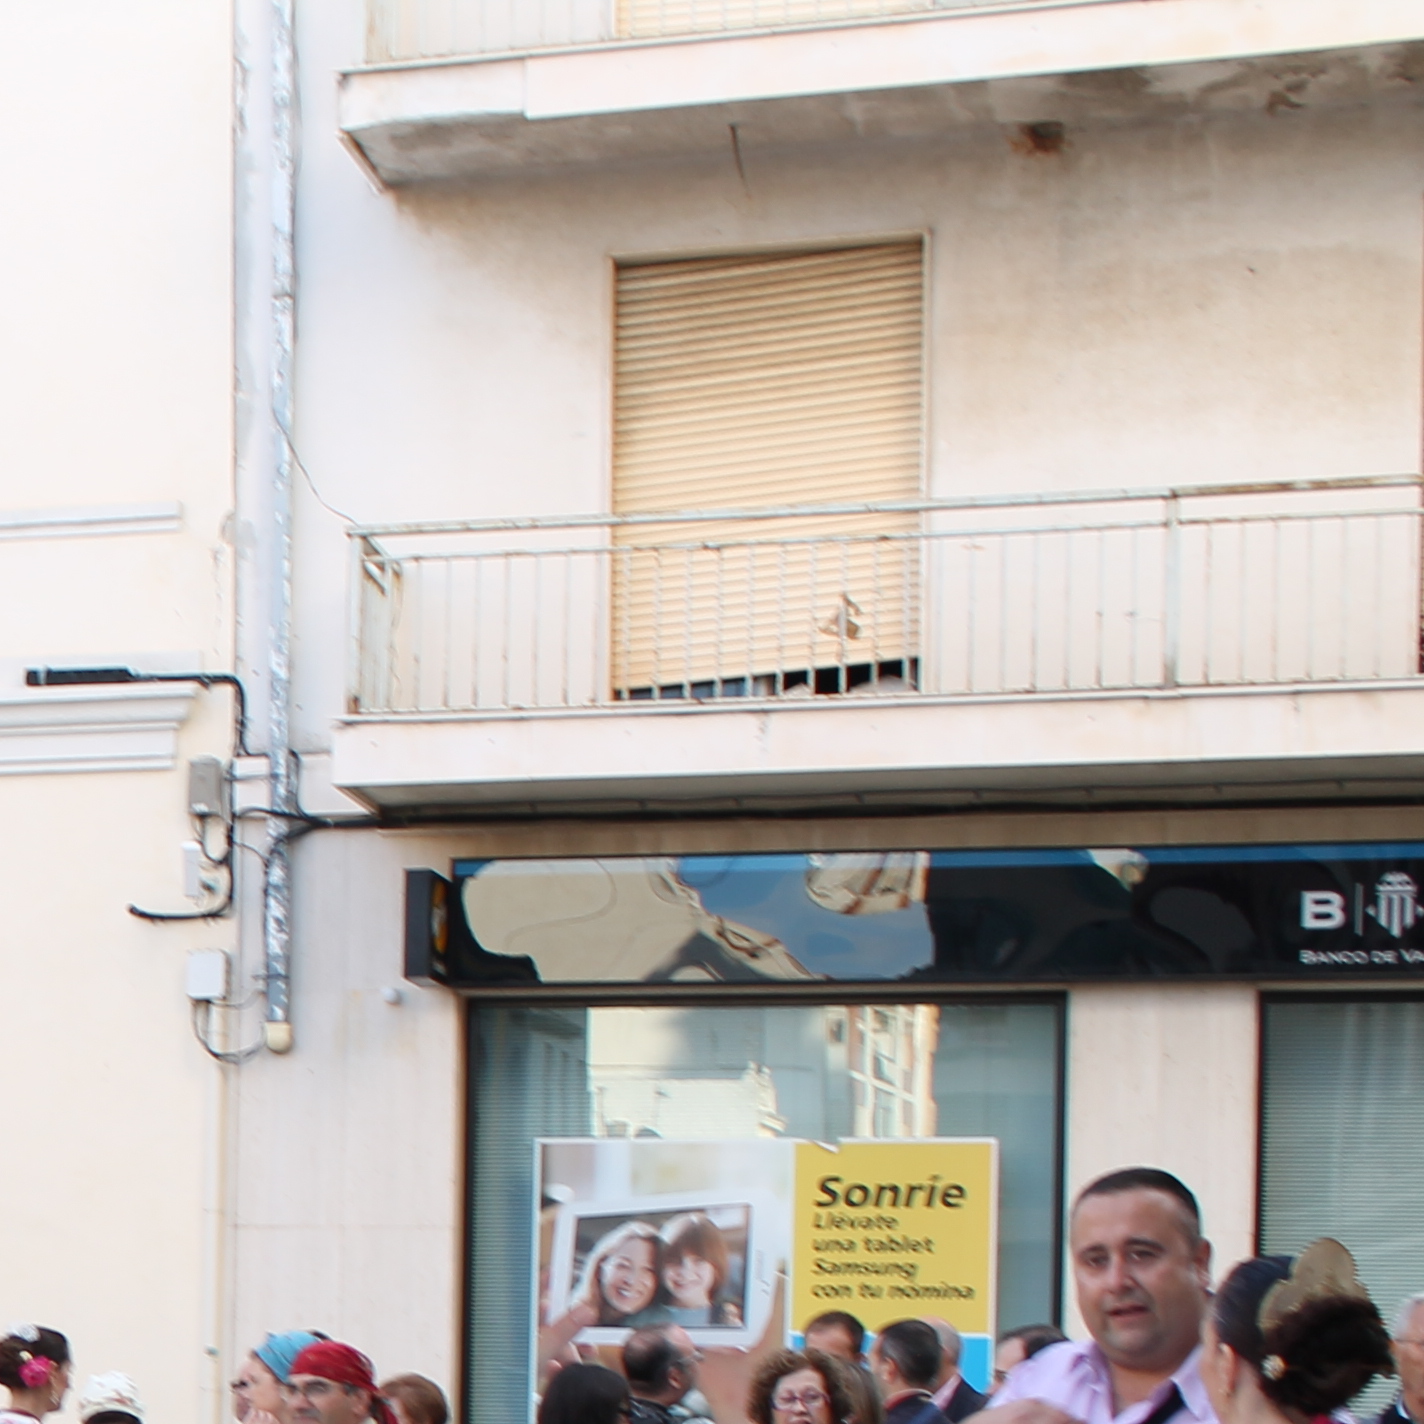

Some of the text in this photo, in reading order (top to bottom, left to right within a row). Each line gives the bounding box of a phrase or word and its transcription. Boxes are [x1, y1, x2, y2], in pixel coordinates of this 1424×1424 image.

[1300, 890, 1346, 930] B
[1299, 950, 1370, 965] BANCO
[1371, 950, 1399, 965] DE
[812, 1234, 936, 1254] una tablet
[810, 1257, 919, 1282] Samsung
[811, 1283, 853, 1298] con
[857, 1282, 884, 1298] tu
